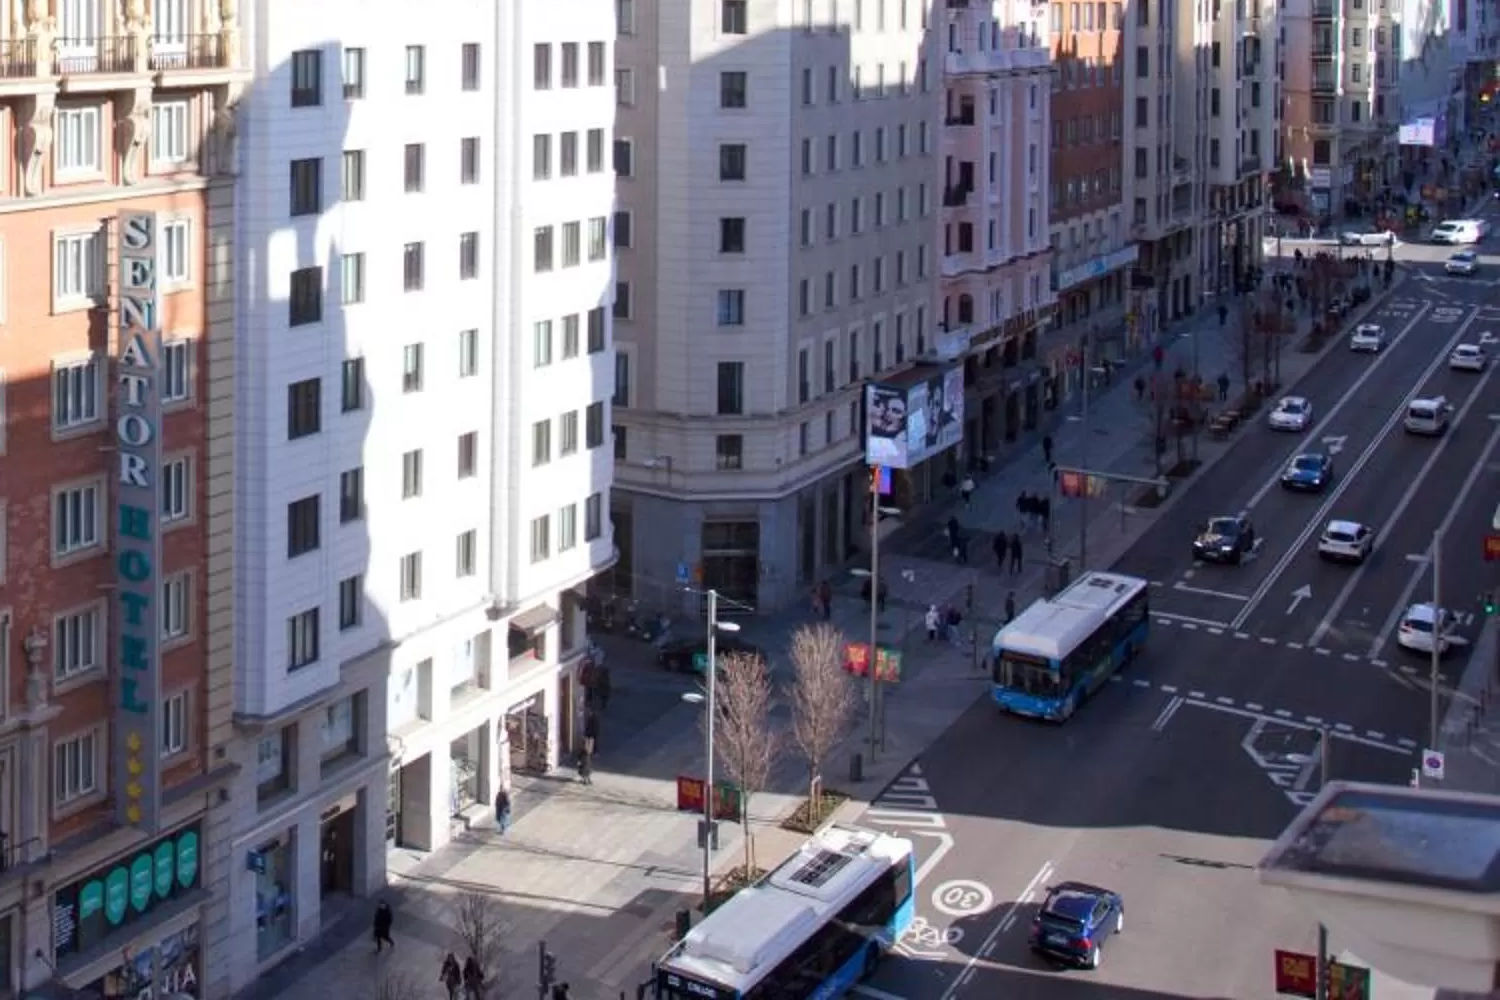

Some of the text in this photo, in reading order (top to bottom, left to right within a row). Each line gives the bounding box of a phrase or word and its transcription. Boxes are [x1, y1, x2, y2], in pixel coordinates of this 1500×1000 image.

[117, 214, 152, 714] SENATOR HOTEL
[944, 887, 980, 908] 30
